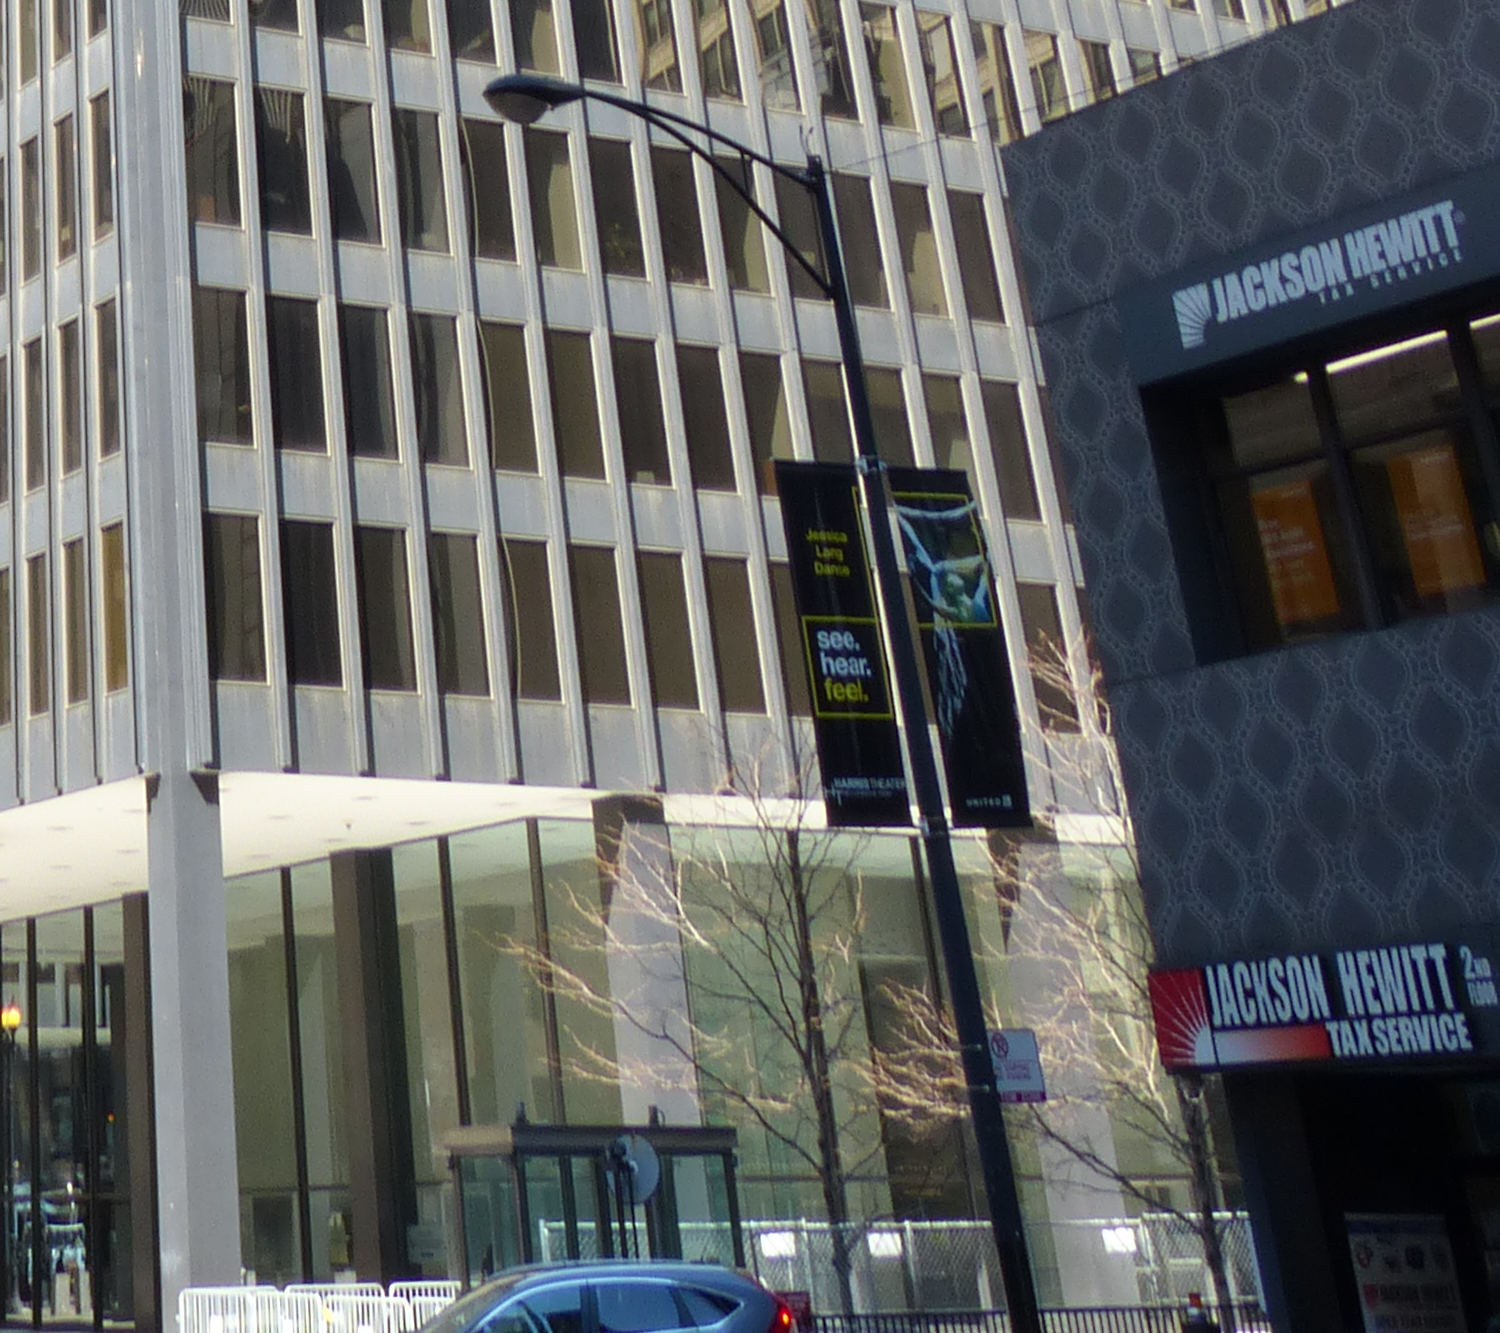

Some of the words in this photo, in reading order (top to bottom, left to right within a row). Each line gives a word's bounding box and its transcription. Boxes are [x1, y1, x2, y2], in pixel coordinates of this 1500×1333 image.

[1213, 238, 1347, 323] JACKSON
[1344, 200, 1459, 279] HEWITT
[1319, 283, 1354, 305] TAX
[1370, 247, 1463, 288] SERVICE
[816, 630, 860, 651] see.
[820, 651, 872, 676] hear.
[824, 677, 870, 702] feel.
[1205, 954, 1331, 1026] JACKSON
[1336, 943, 1454, 1016] HEWITT
[1326, 1019, 1374, 1057] TAX
[1371, 1012, 1474, 1056] SERVICE
